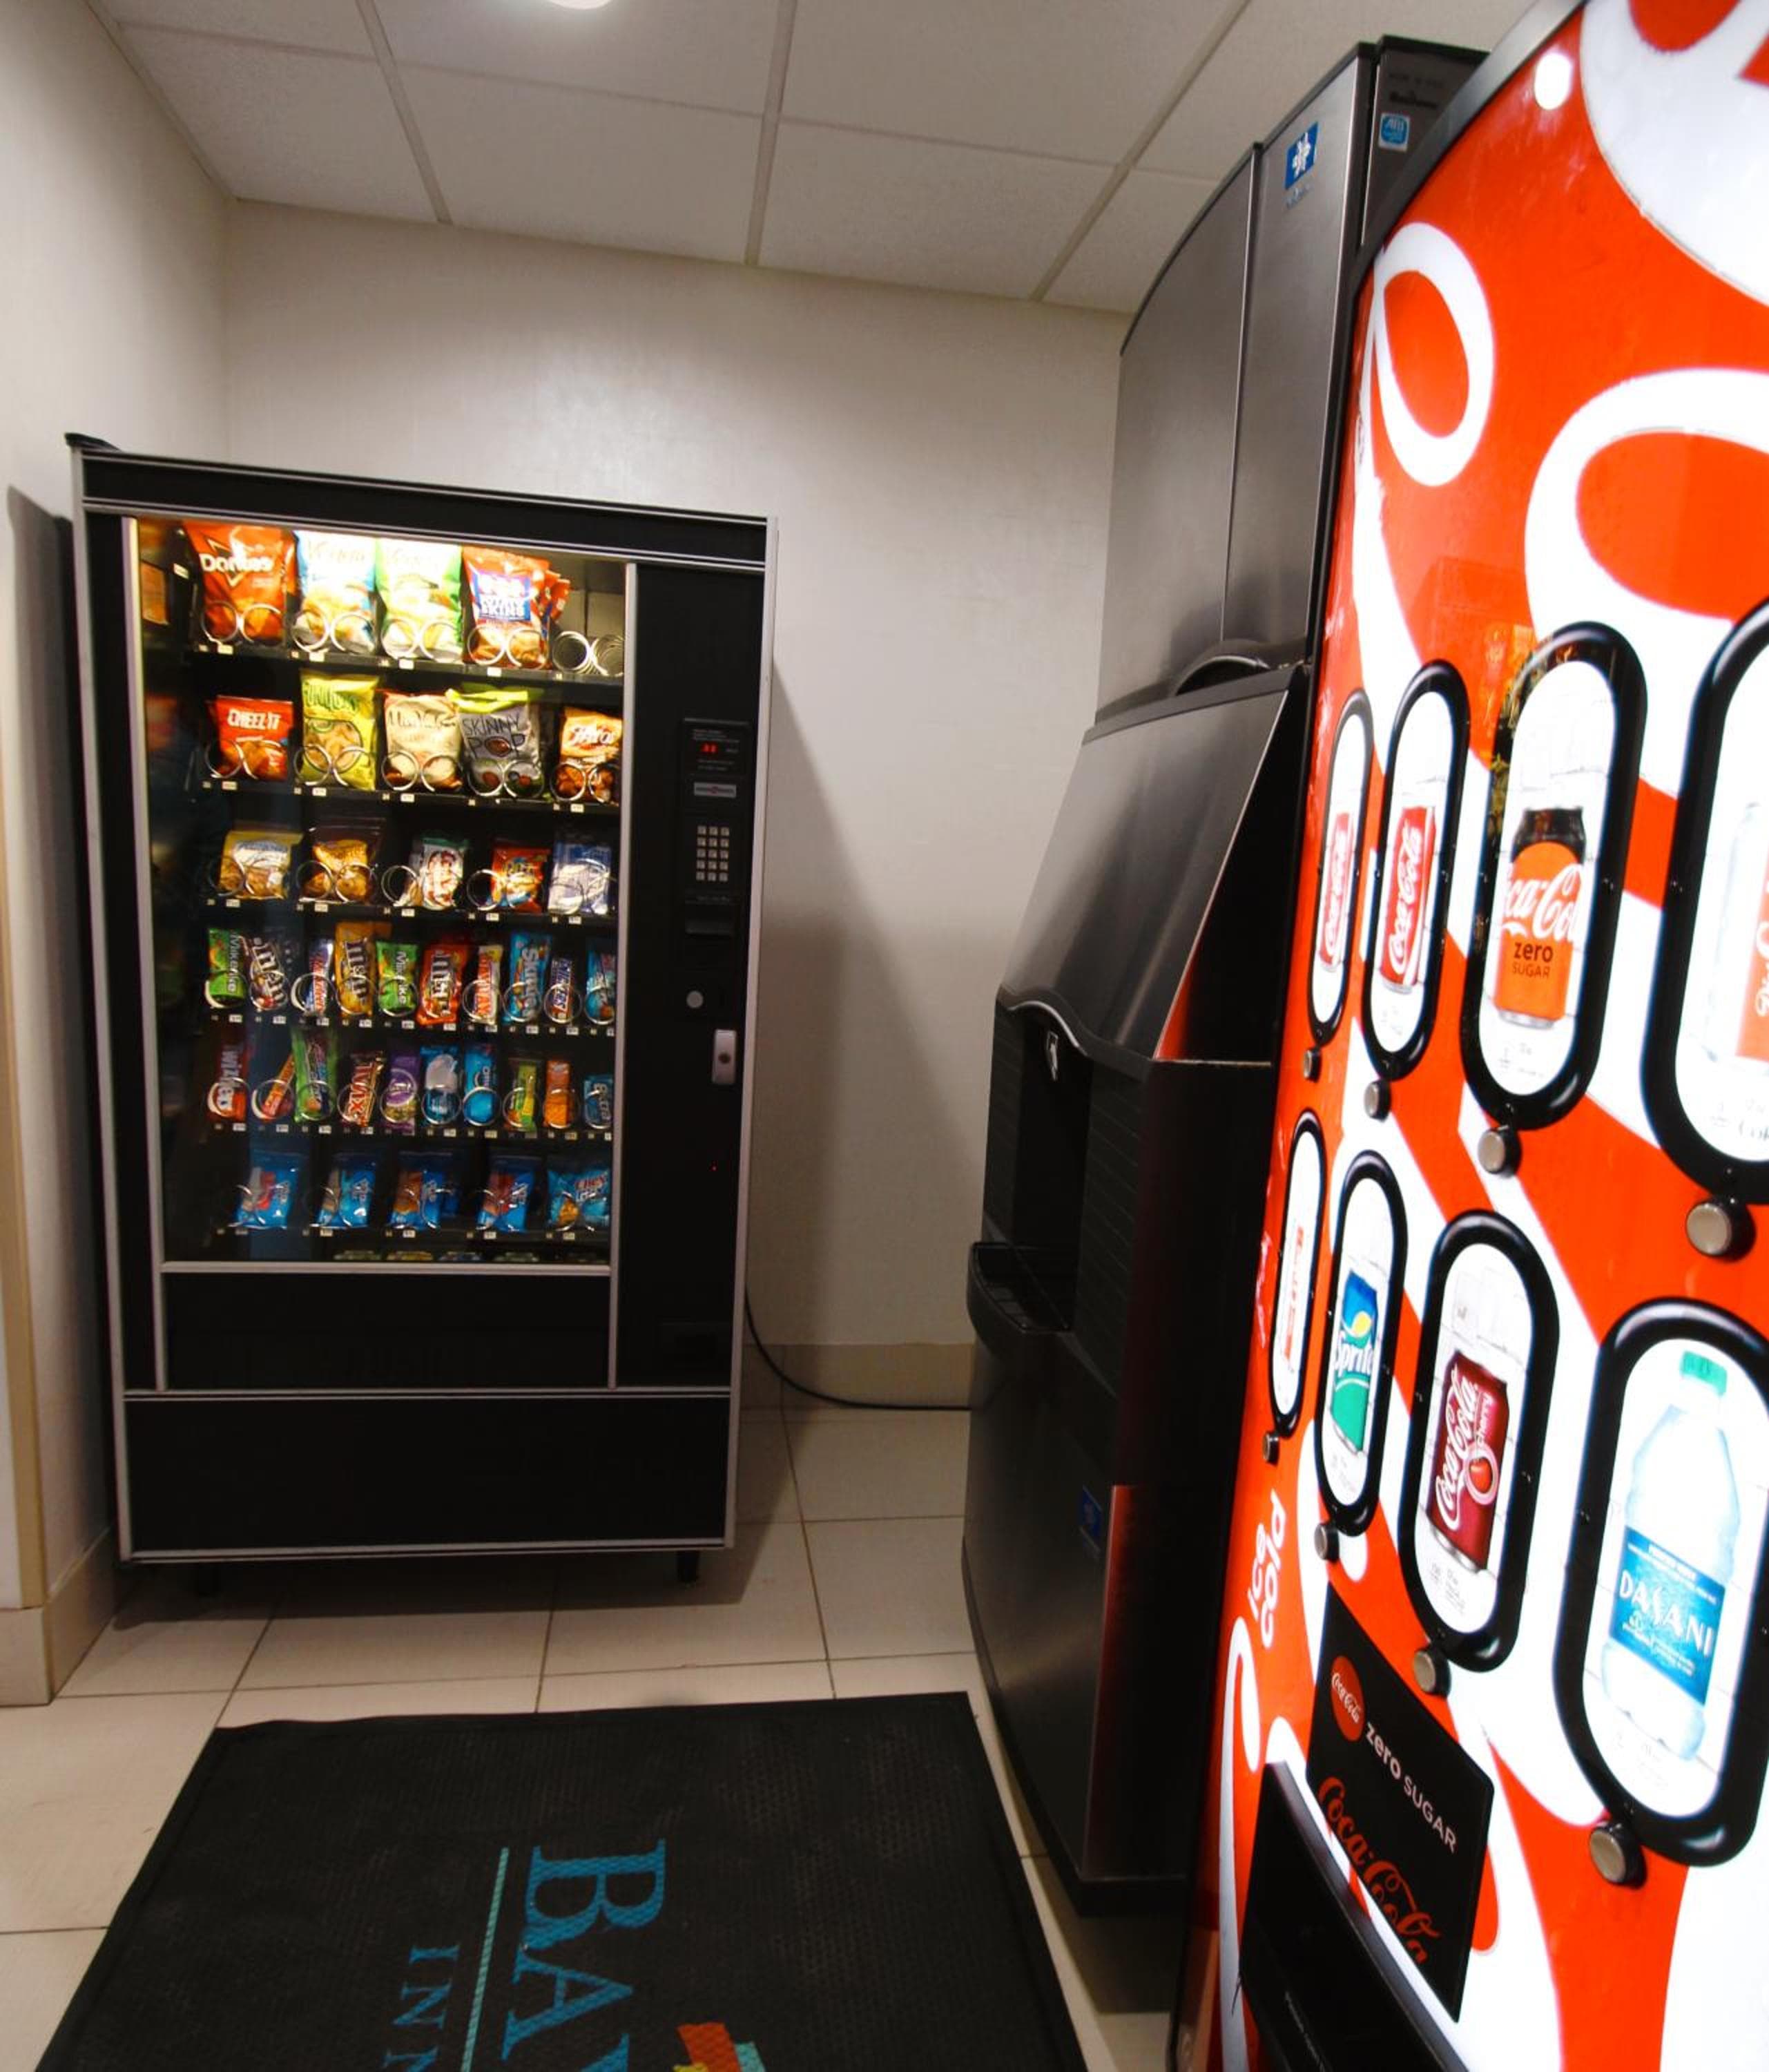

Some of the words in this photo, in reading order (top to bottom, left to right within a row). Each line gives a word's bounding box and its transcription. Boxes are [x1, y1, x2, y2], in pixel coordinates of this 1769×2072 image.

[200, 553, 273, 573] Doritos
[462, 714, 519, 736] SKINNY
[1389, 820, 1423, 975] Coca-Cola
[1511, 962, 1551, 979] SUGAR
[1514, 941, 1554, 963] zero
[1436, 1363, 1479, 1531] Coca-Cola
[1619, 1569, 1714, 1658] DASANI
[1331, 1672, 1361, 1724] Coca-Cola
[1364, 1722, 1402, 1781] zero
[1403, 1775, 1458, 1854] SUGAR
[1317, 1776, 1442, 1964] Coca-Cola
